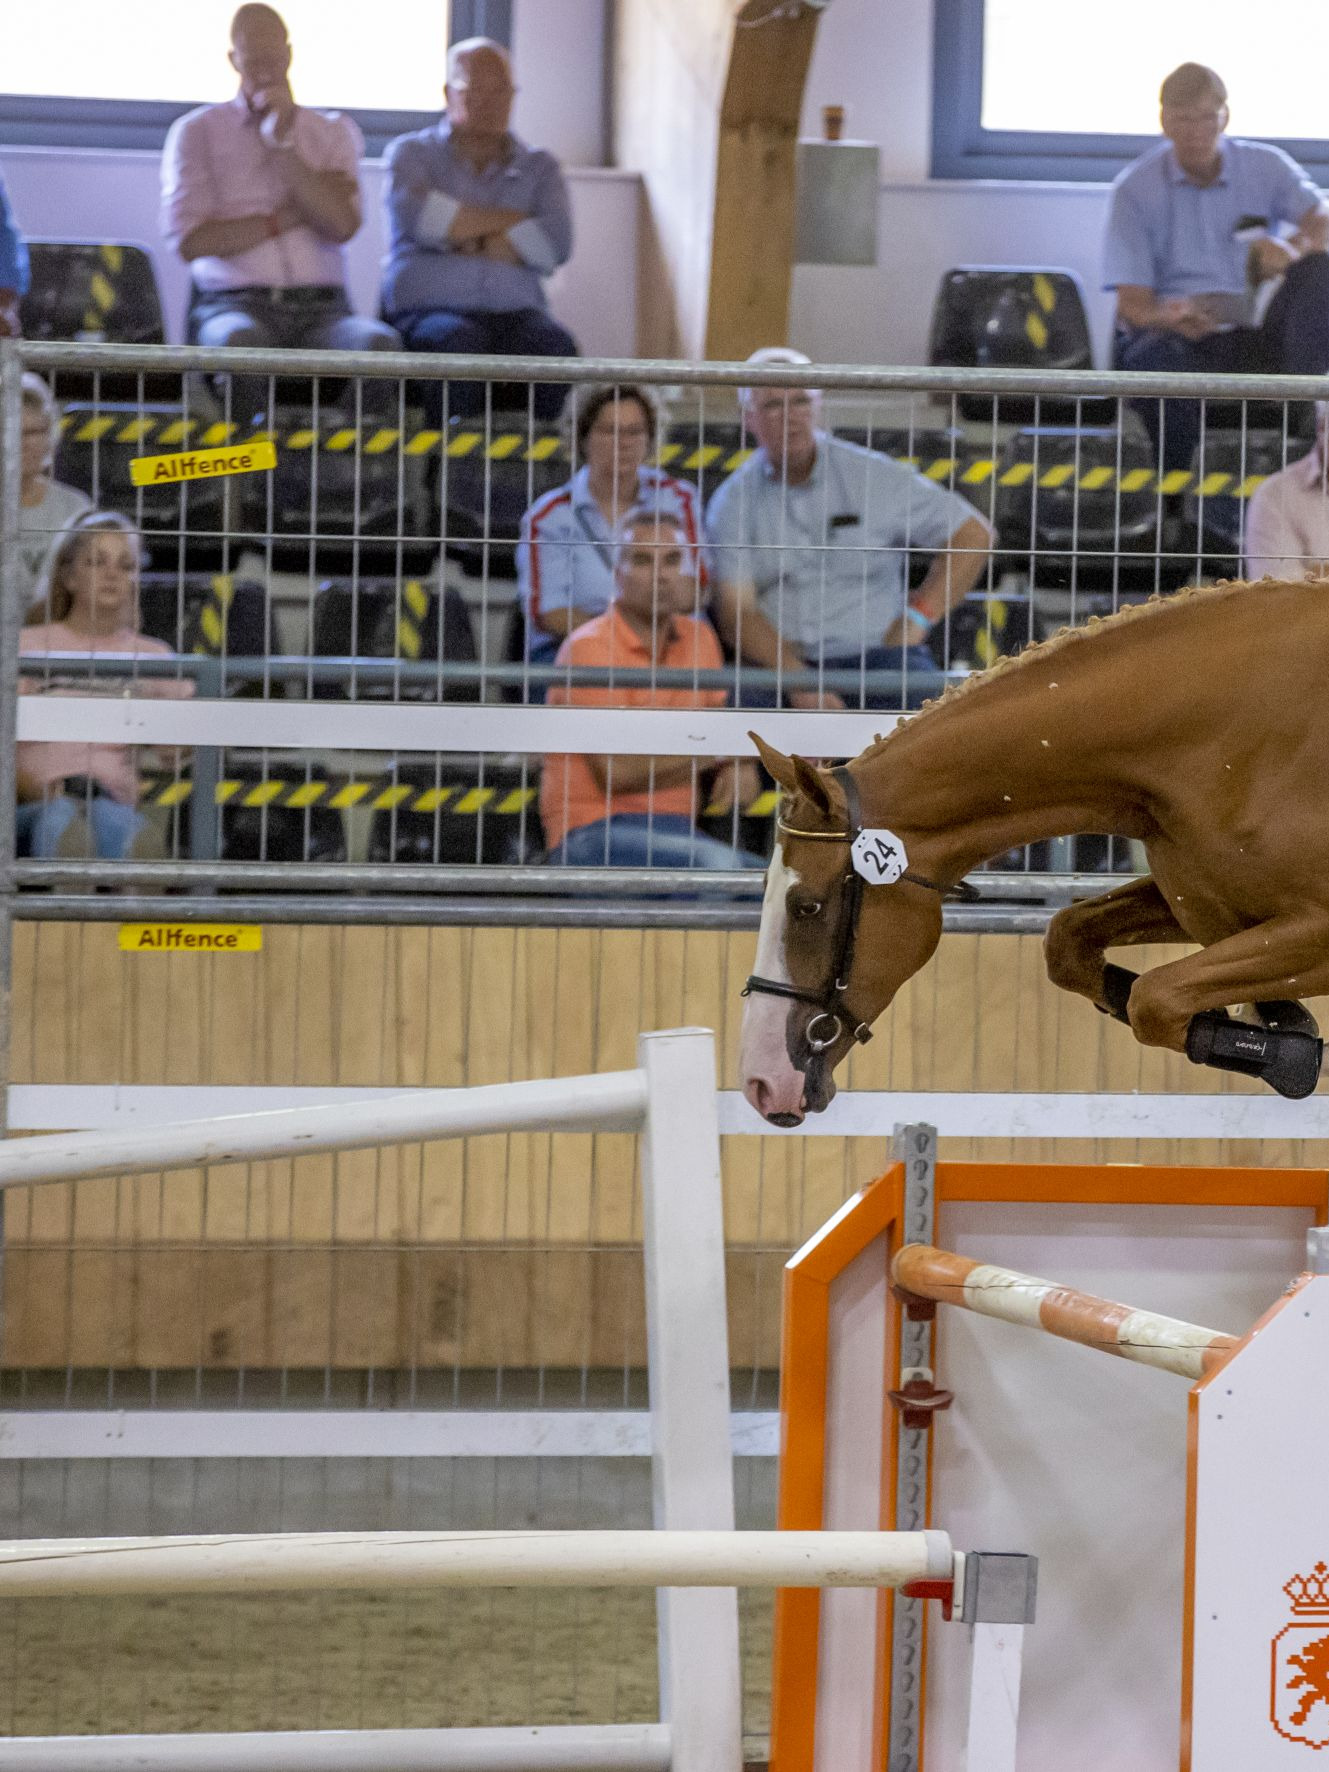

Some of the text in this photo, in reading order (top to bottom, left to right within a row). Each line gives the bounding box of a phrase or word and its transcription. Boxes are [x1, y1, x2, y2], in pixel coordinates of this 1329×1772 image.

[153, 454, 253, 480] Allfence
[862, 837, 898, 876] 24
[138, 928, 238, 948] Allfence
